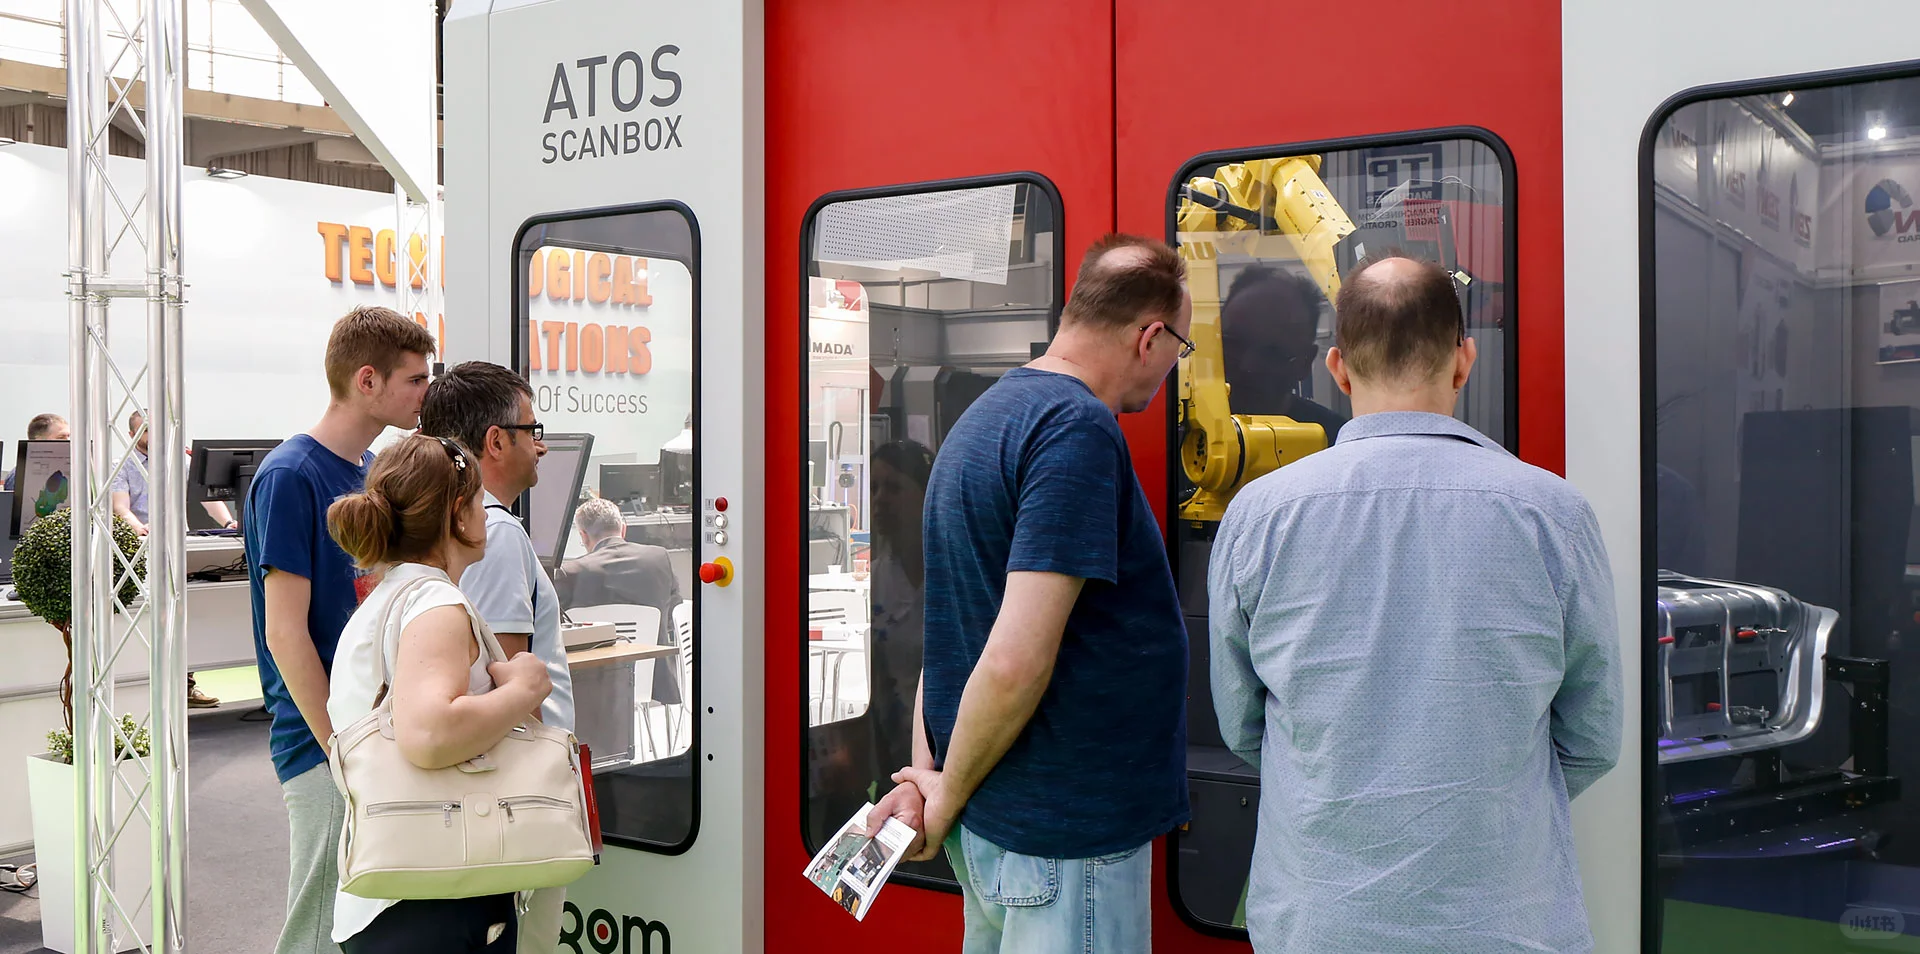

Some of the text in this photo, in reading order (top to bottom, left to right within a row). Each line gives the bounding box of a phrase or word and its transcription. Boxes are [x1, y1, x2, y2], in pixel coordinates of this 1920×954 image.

[543, 44, 682, 123] ATOS
[542, 115, 682, 164] SCANBOX
[809, 337, 853, 355] MADA
[538, 385, 648, 414] Of Success
